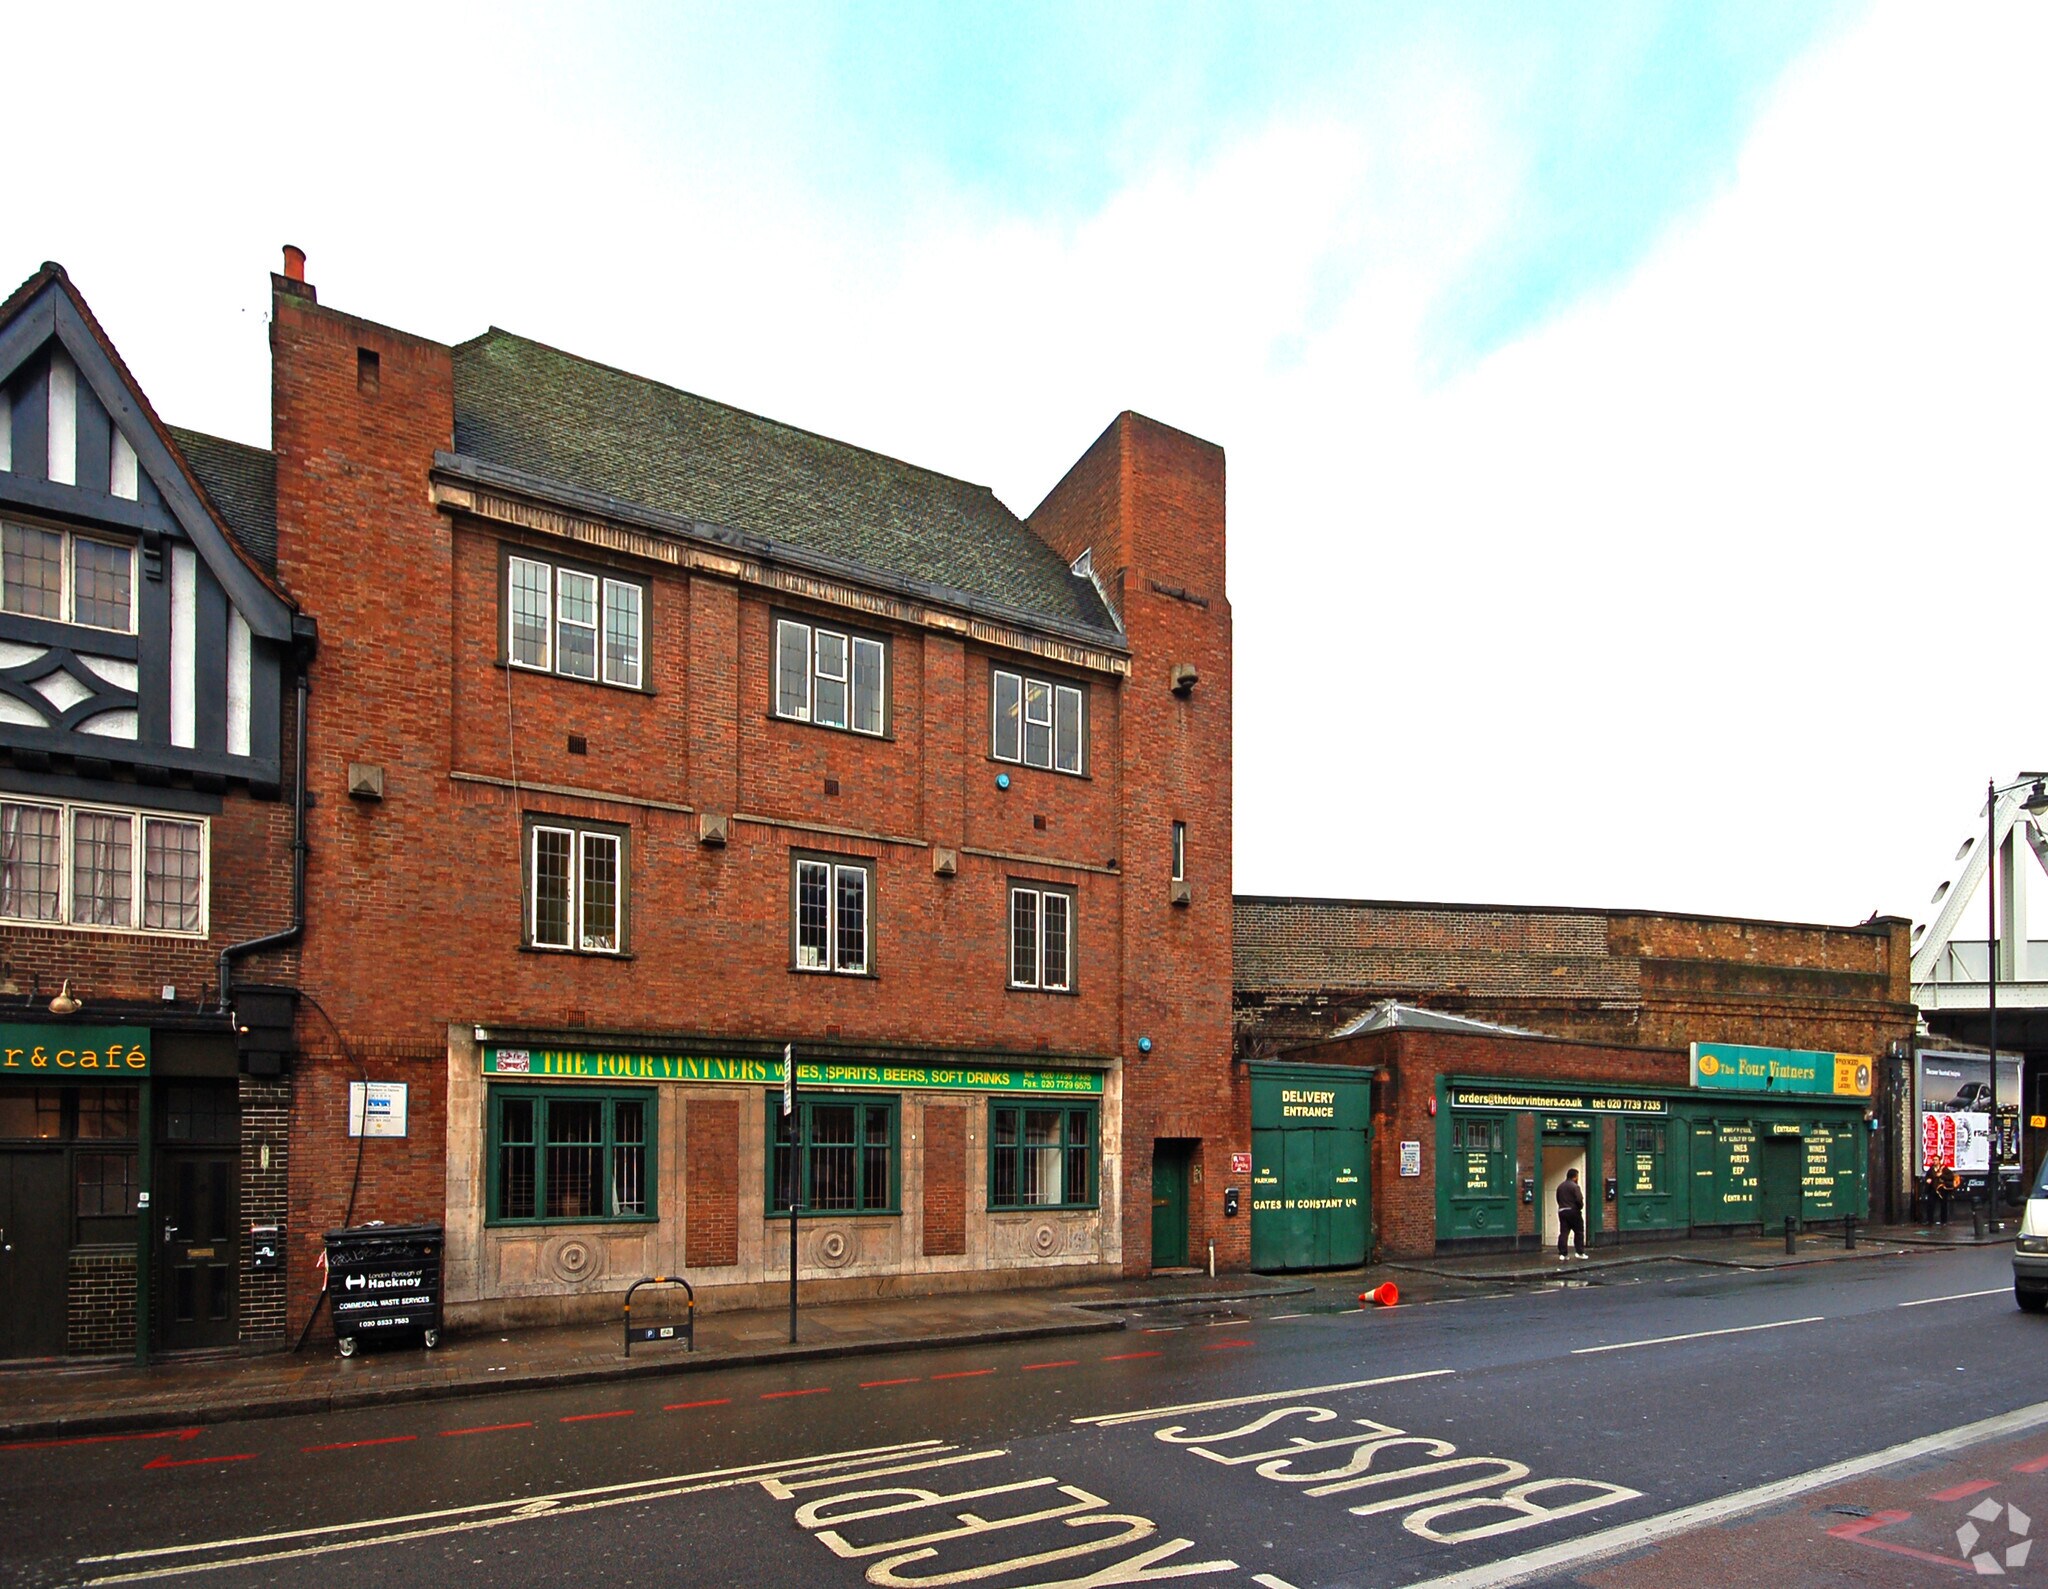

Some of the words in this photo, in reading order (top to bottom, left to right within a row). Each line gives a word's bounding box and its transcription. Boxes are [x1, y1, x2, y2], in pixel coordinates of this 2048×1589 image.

[540, 1050, 588, 1075] THE
[596, 1053, 654, 1077] FOUR
[662, 1055, 766, 1081] VINTNERS
[774, 1063, 823, 1080] WNES,
[826, 1065, 881, 1082] SPIRITS,
[883, 1068, 928, 1084] BEERS,
[931, 1070, 964, 1084] SOFT
[966, 1071, 1010, 1086] DRINKS
[1720, 1064, 1735, 1075] The
[1739, 1058, 1765, 1077] Four
[1769, 1060, 1815, 1080] Vintners
[1041, 1080, 1054, 1088] 020
[1282, 1090, 1336, 1104] DELIVERY
[1458, 1092, 1583, 1108] orders@thefourvintners.co.uk
[1592, 1098, 1606, 1109] tel:
[1606, 1099, 1622, 1110] 020
[1623, 1100, 1642, 1110] 7739
[1642, 1100, 1661, 1111] 7335
[1283, 1106, 1334, 1118] ENTRANCE
[1253, 1200, 1282, 1210] GATES
[1285, 1200, 1295, 1209] IN
[1297, 1199, 1343, 1209] CONSTANT
[391, 1270, 415, 1278] Borough
[368, 1277, 422, 1289] Hackney
[339, 1300, 379, 1310] COMMERCIAL
[380, 1298, 400, 1306] WASTE
[401, 1296, 430, 1305] SERVICES
[1153, 1405, 1645, 1546] BUSES
[760, 1449, 1298, 1589] XCEPT
